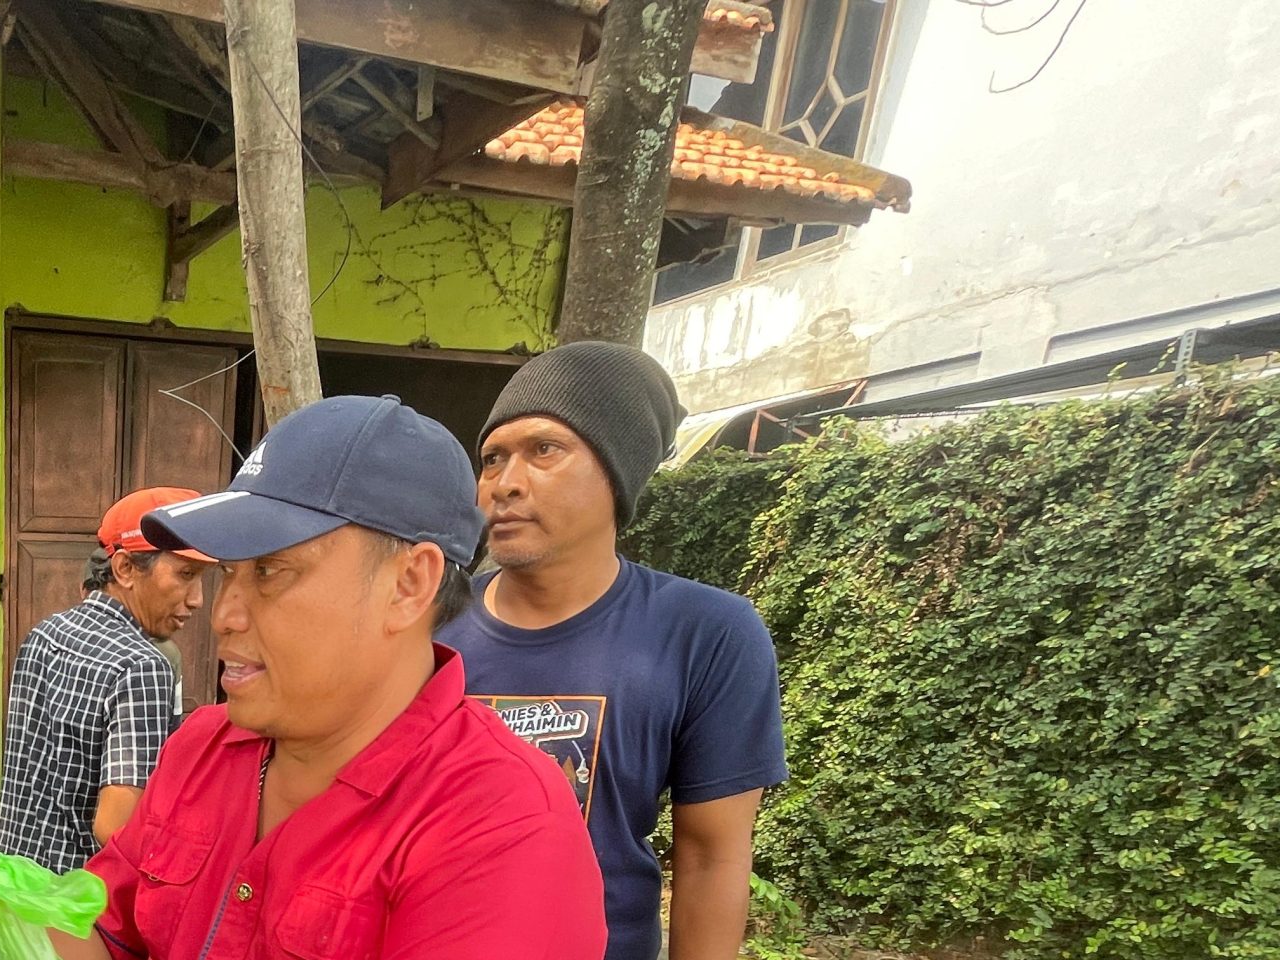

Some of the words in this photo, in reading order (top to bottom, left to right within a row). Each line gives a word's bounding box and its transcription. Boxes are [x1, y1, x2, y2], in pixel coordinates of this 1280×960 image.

[499, 705, 537, 722] NIES
[540, 703, 552, 716] &
[508, 713, 578, 733] HAIMIN
